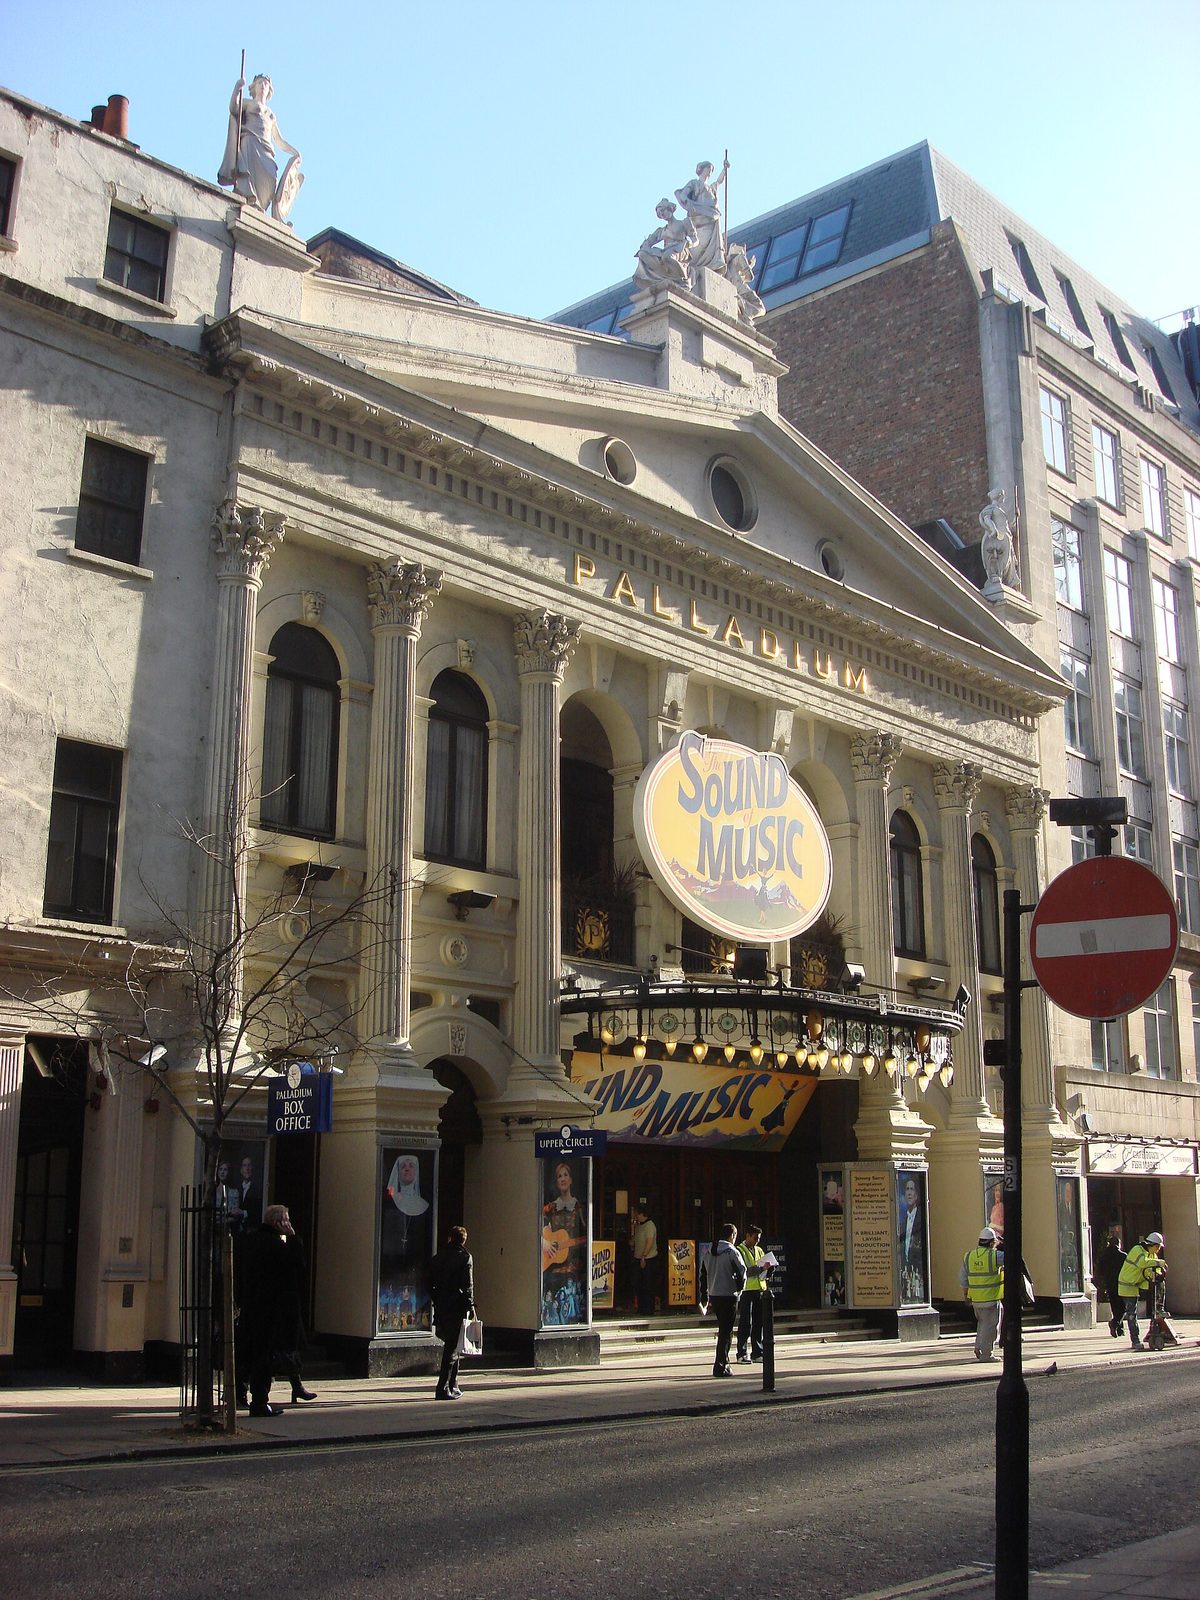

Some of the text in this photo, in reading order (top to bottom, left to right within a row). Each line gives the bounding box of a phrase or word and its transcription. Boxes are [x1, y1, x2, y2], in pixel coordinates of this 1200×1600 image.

[574, 551, 867, 694] PALLADIUM
[702, 751, 722, 772] The
[677, 733, 789, 818] SOUND
[743, 808, 754, 829] of
[697, 815, 804, 881] MUSIC
[276, 1088, 313, 1100] PALLADIUM
[584, 1064, 771, 1138] UND of MUSIC
[284, 1100, 304, 1115] BOX
[275, 1115, 311, 1132] OFFICE
[539, 1137, 594, 1149] UPPER CIRCLE
[1005, 1159, 1013, 1171] S
[1006, 1177, 1013, 1189] 2
